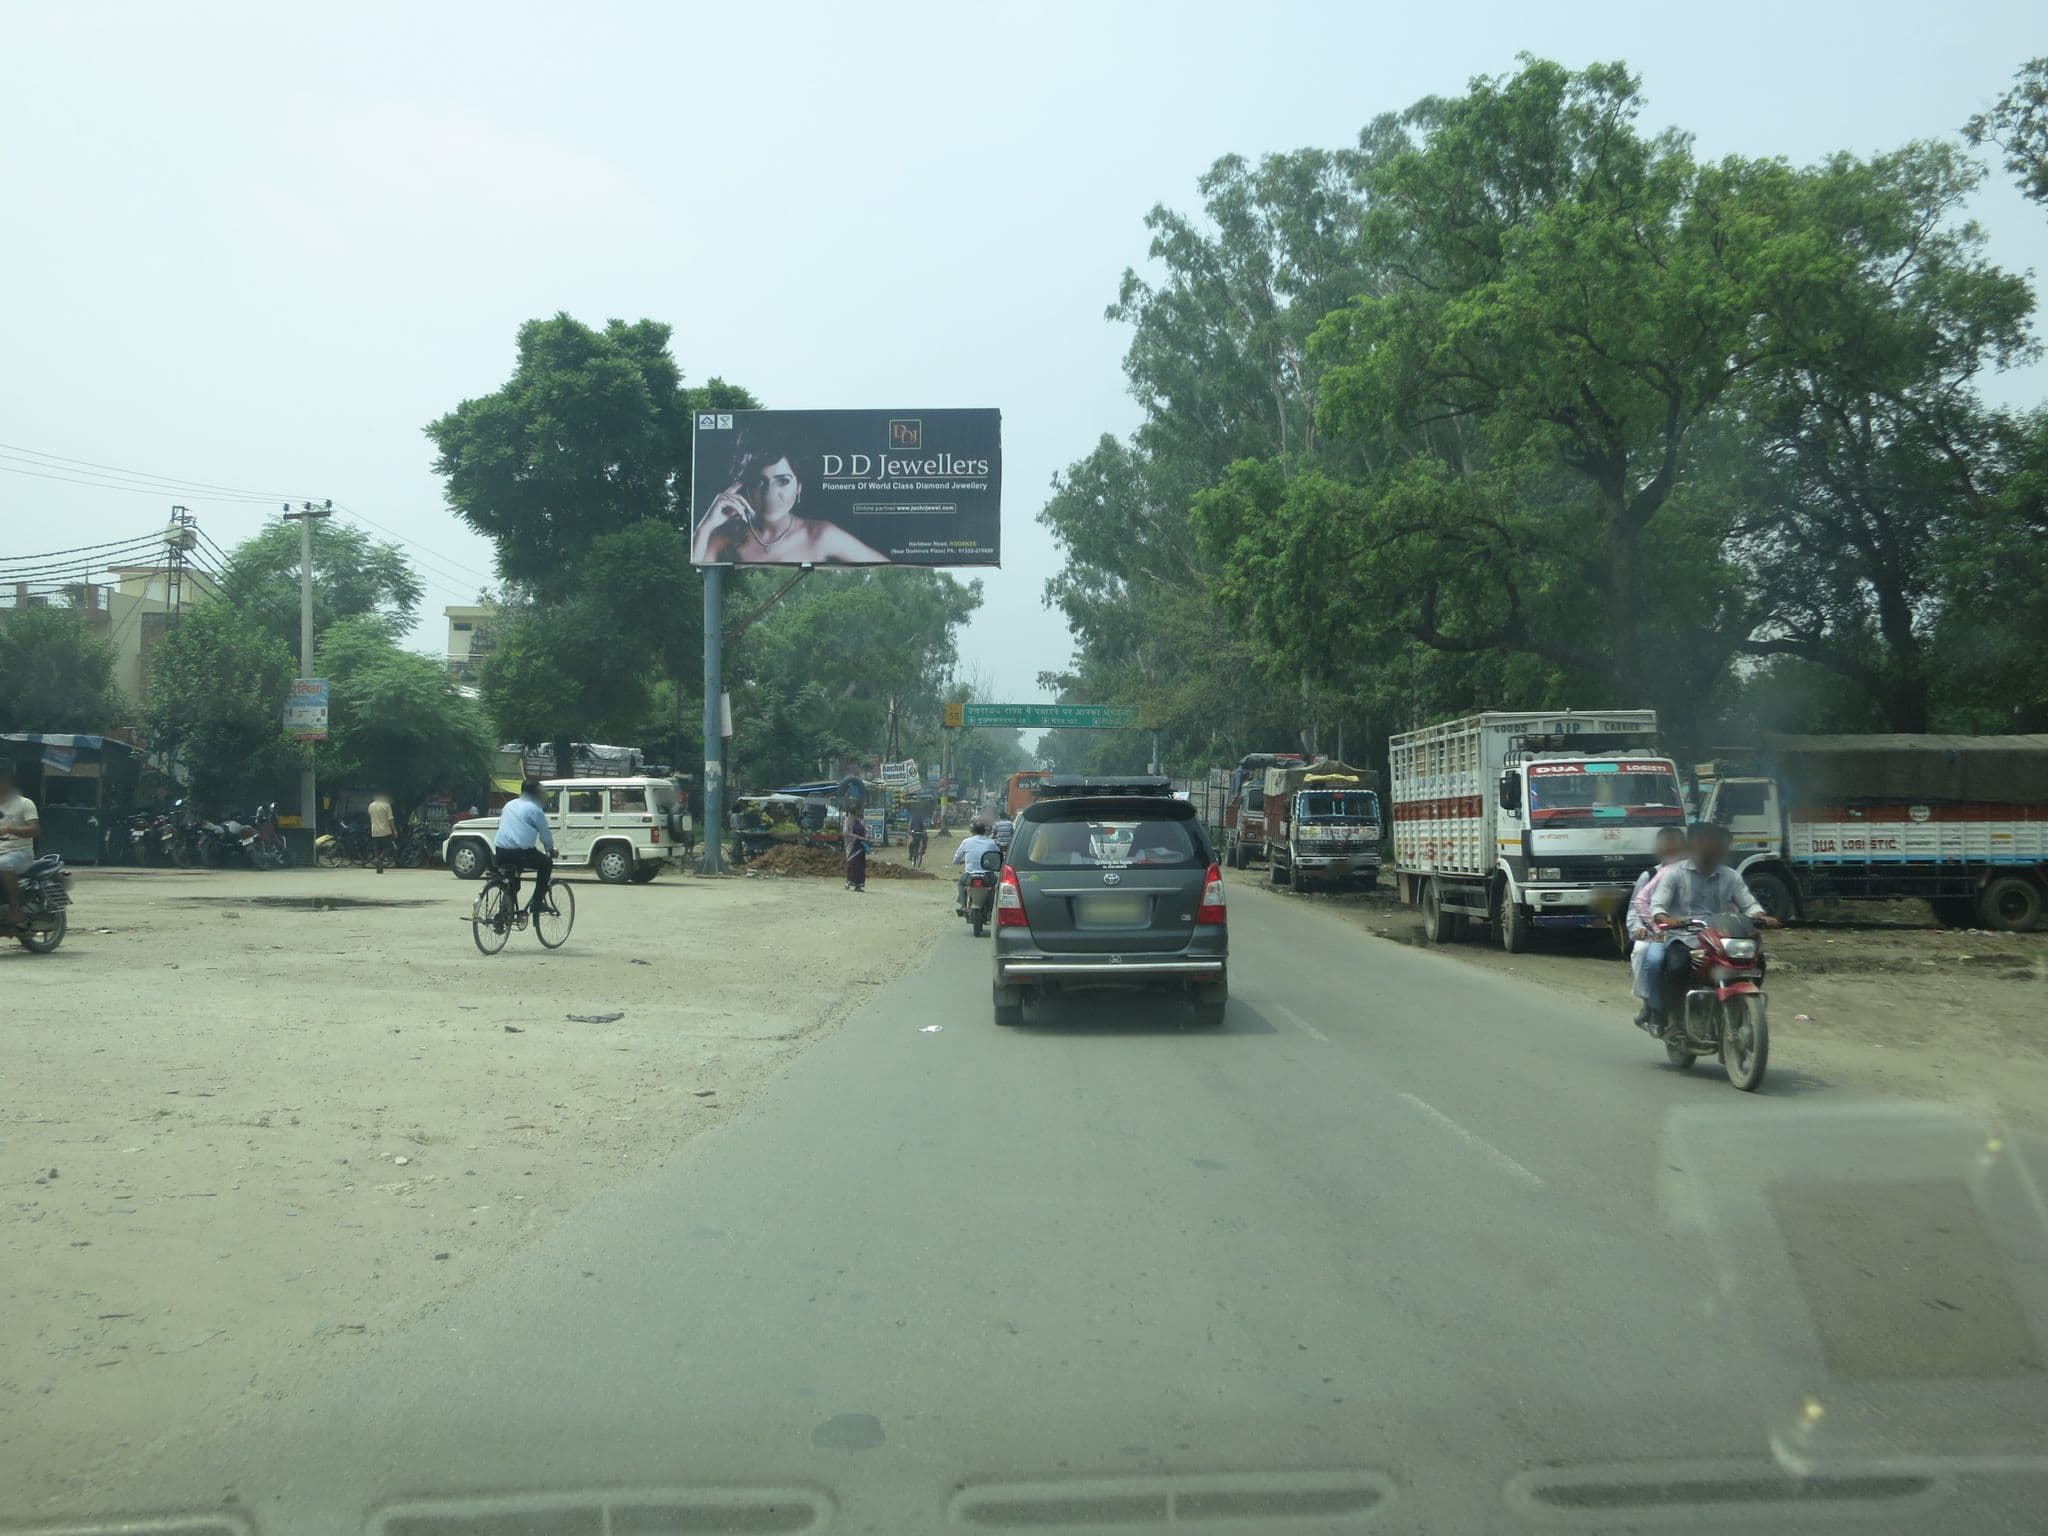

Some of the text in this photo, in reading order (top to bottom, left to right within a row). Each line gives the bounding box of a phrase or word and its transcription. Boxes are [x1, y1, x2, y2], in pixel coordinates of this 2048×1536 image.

[822, 453, 989, 481] D D Jewellers
[822, 481, 988, 491] Pioneers Of World Class Diamond Jewellery
[948, 711, 961, 721] 58
[1494, 722, 1529, 734] GOODS
[1535, 765, 1579, 774] DUA
[1812, 839, 1836, 853] DUA
